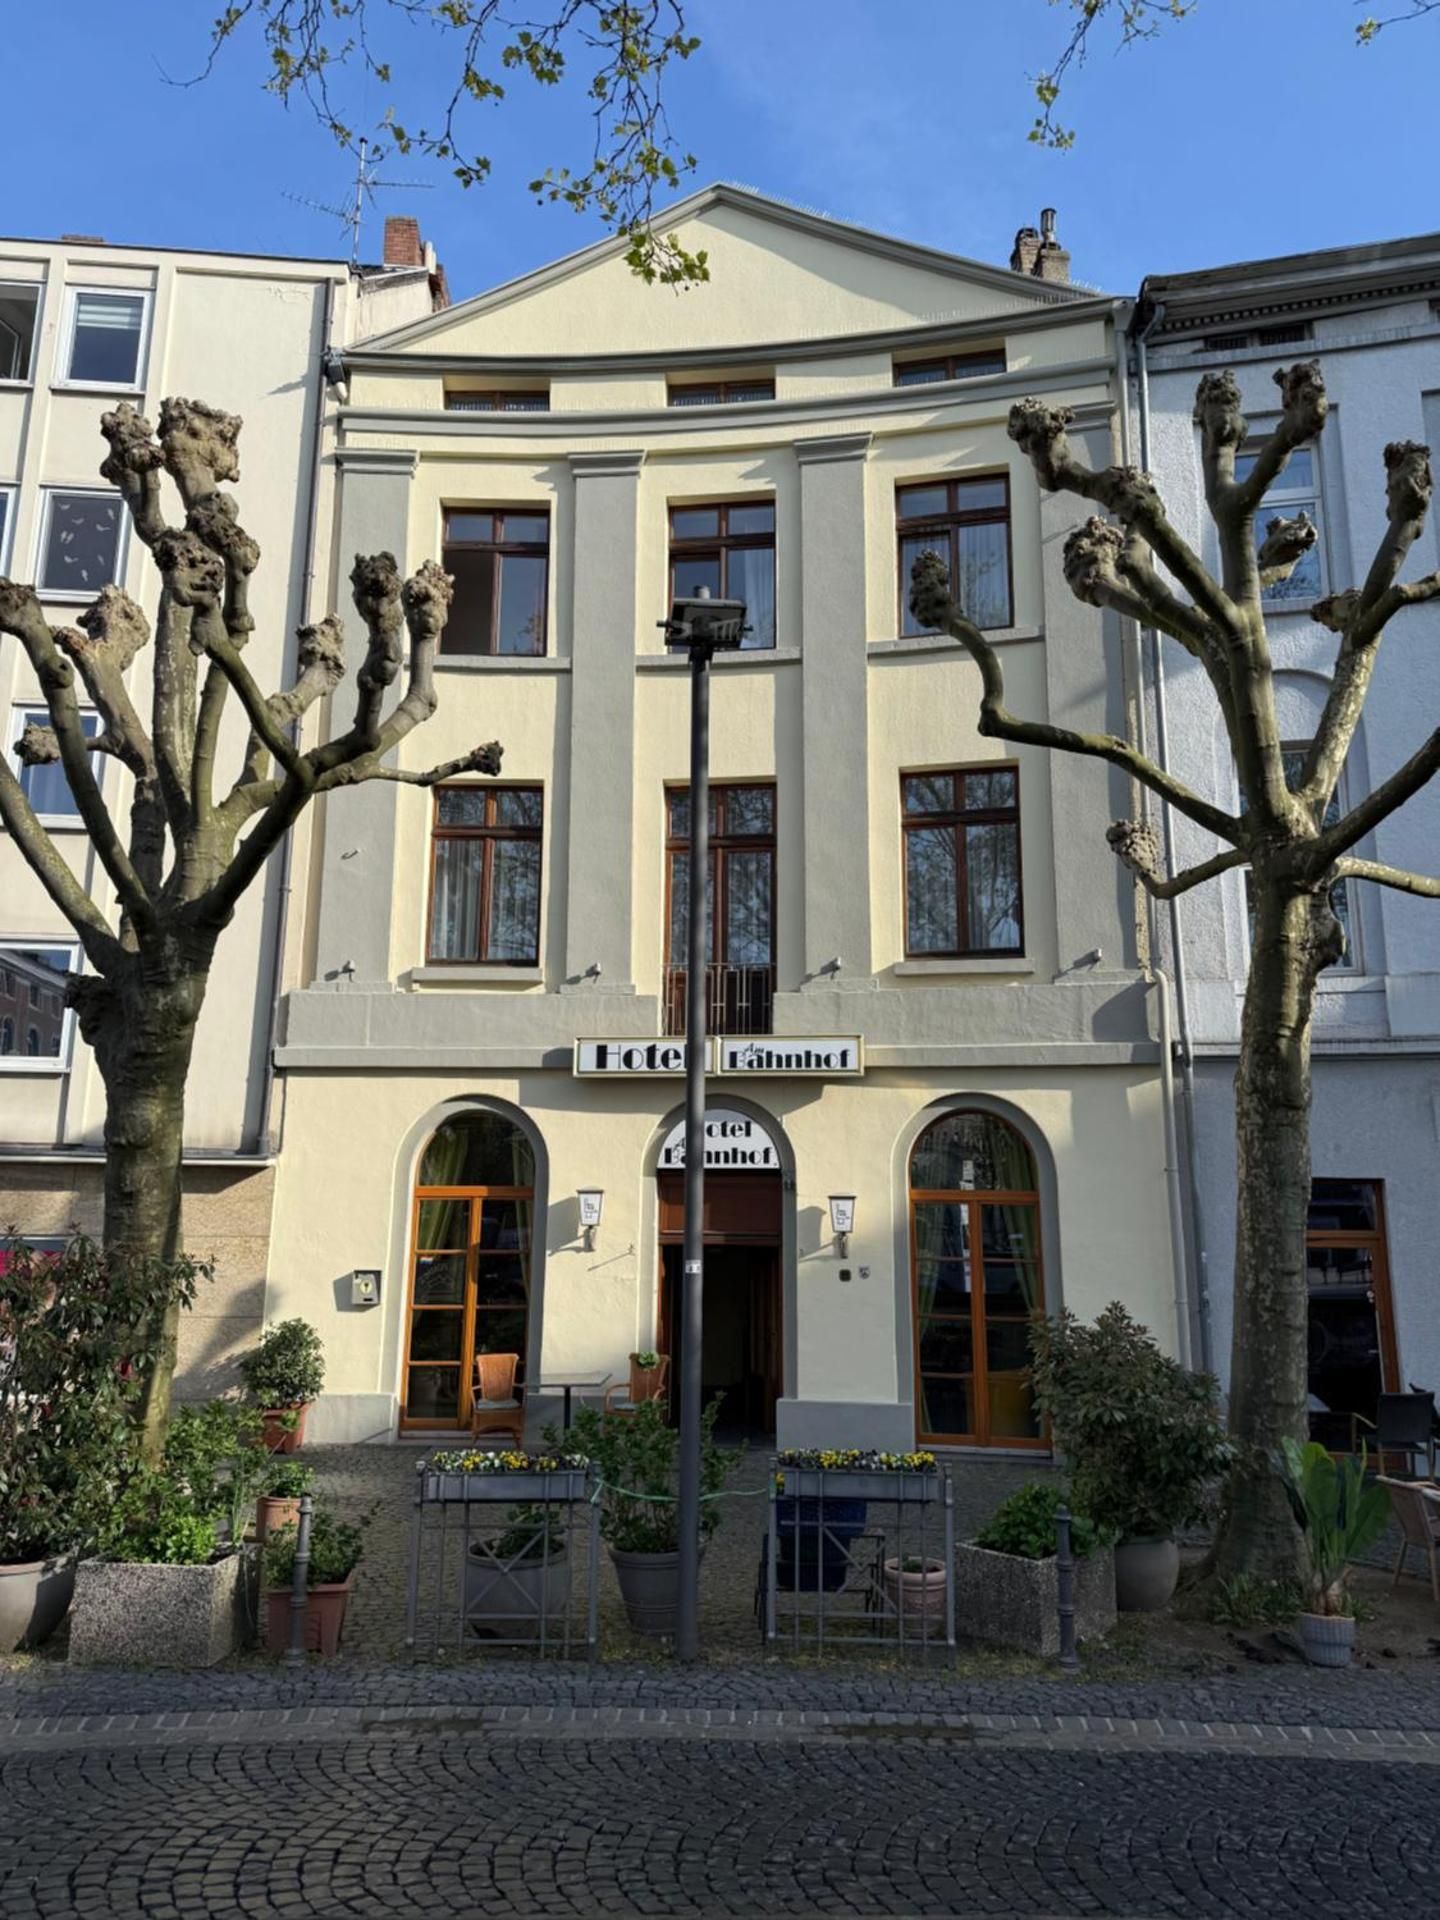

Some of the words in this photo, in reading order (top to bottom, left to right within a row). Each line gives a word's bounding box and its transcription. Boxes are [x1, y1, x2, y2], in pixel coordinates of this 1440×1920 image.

[596, 1044, 687, 1070] Hote
[729, 1049, 851, 1069] Bahnhof
[706, 1120, 752, 1138] otel
